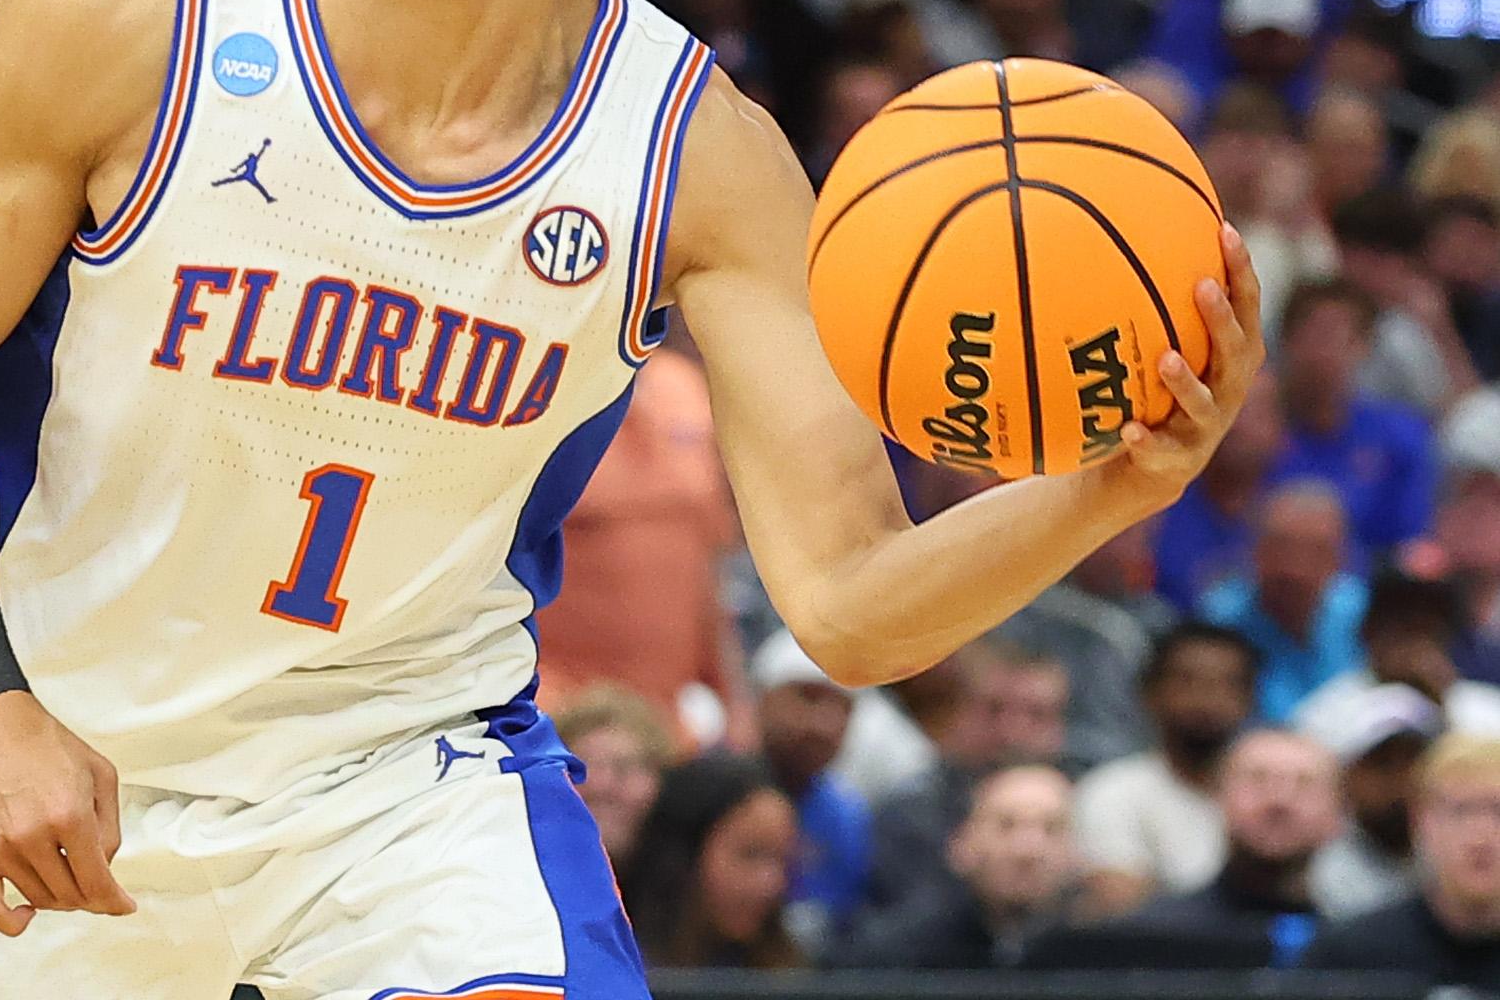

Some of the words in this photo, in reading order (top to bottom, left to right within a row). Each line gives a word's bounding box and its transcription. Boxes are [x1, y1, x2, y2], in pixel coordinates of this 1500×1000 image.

[219, 56, 273, 83] NCAA
[530, 210, 604, 283] SEC
[150, 264, 570, 430] FLORIDA
[259, 462, 376, 634] 1
